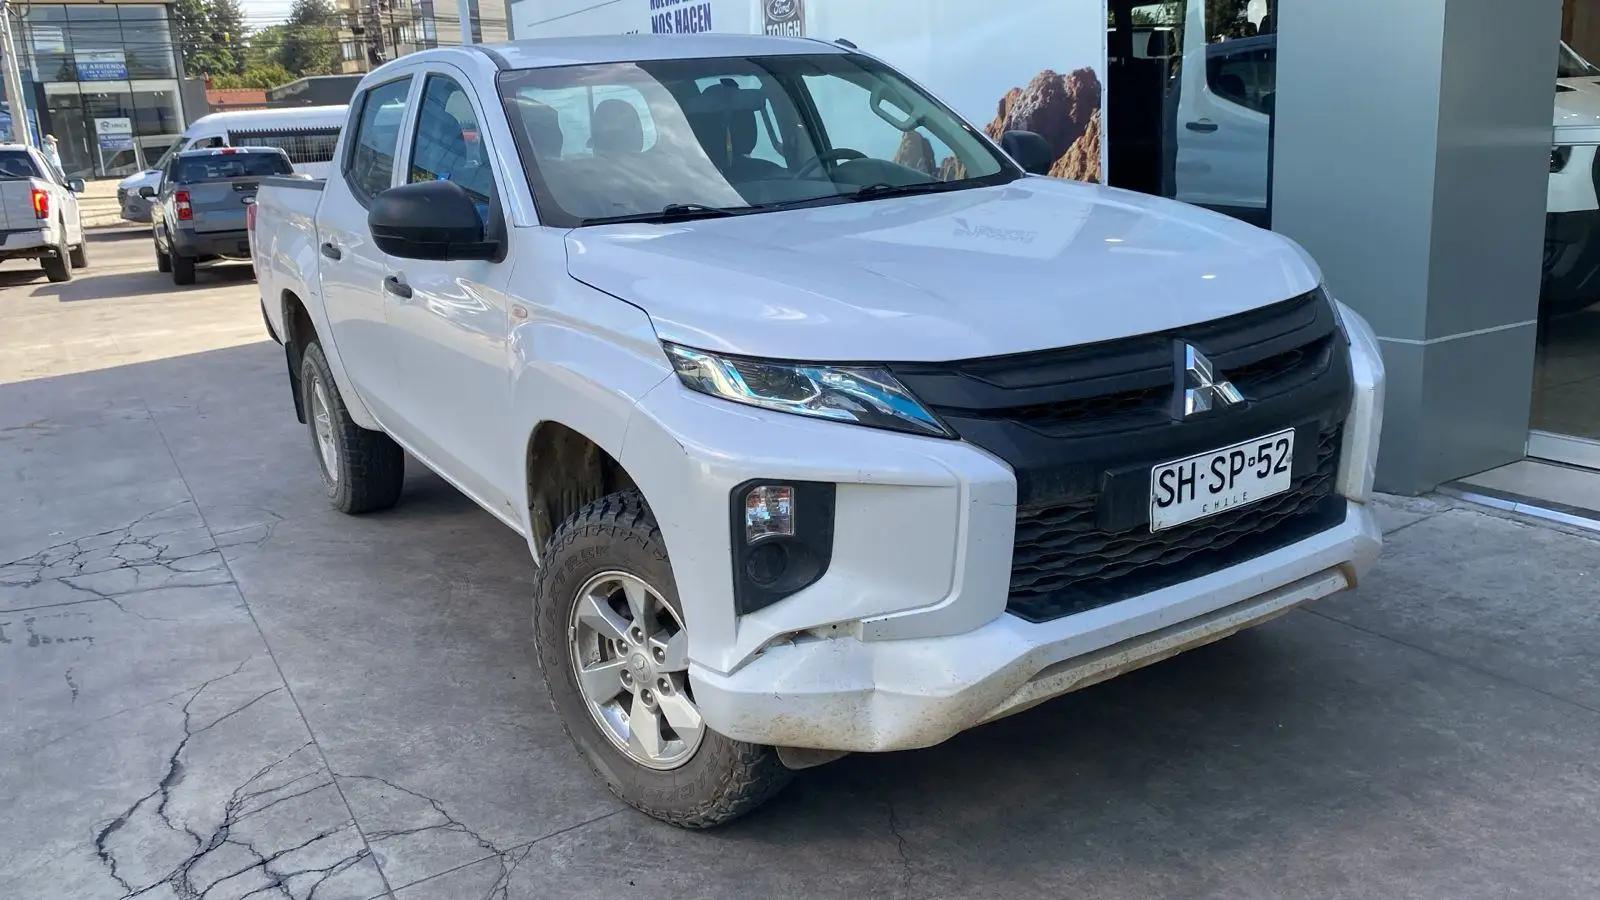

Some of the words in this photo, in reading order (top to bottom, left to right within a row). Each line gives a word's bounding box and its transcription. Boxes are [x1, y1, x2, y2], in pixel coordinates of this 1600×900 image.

[651, 12, 673, 34] NOS
[675, 3, 712, 33] HACEN
[766, 20, 801, 37] TOUGH
[1202, 491, 1248, 513] CHILE
